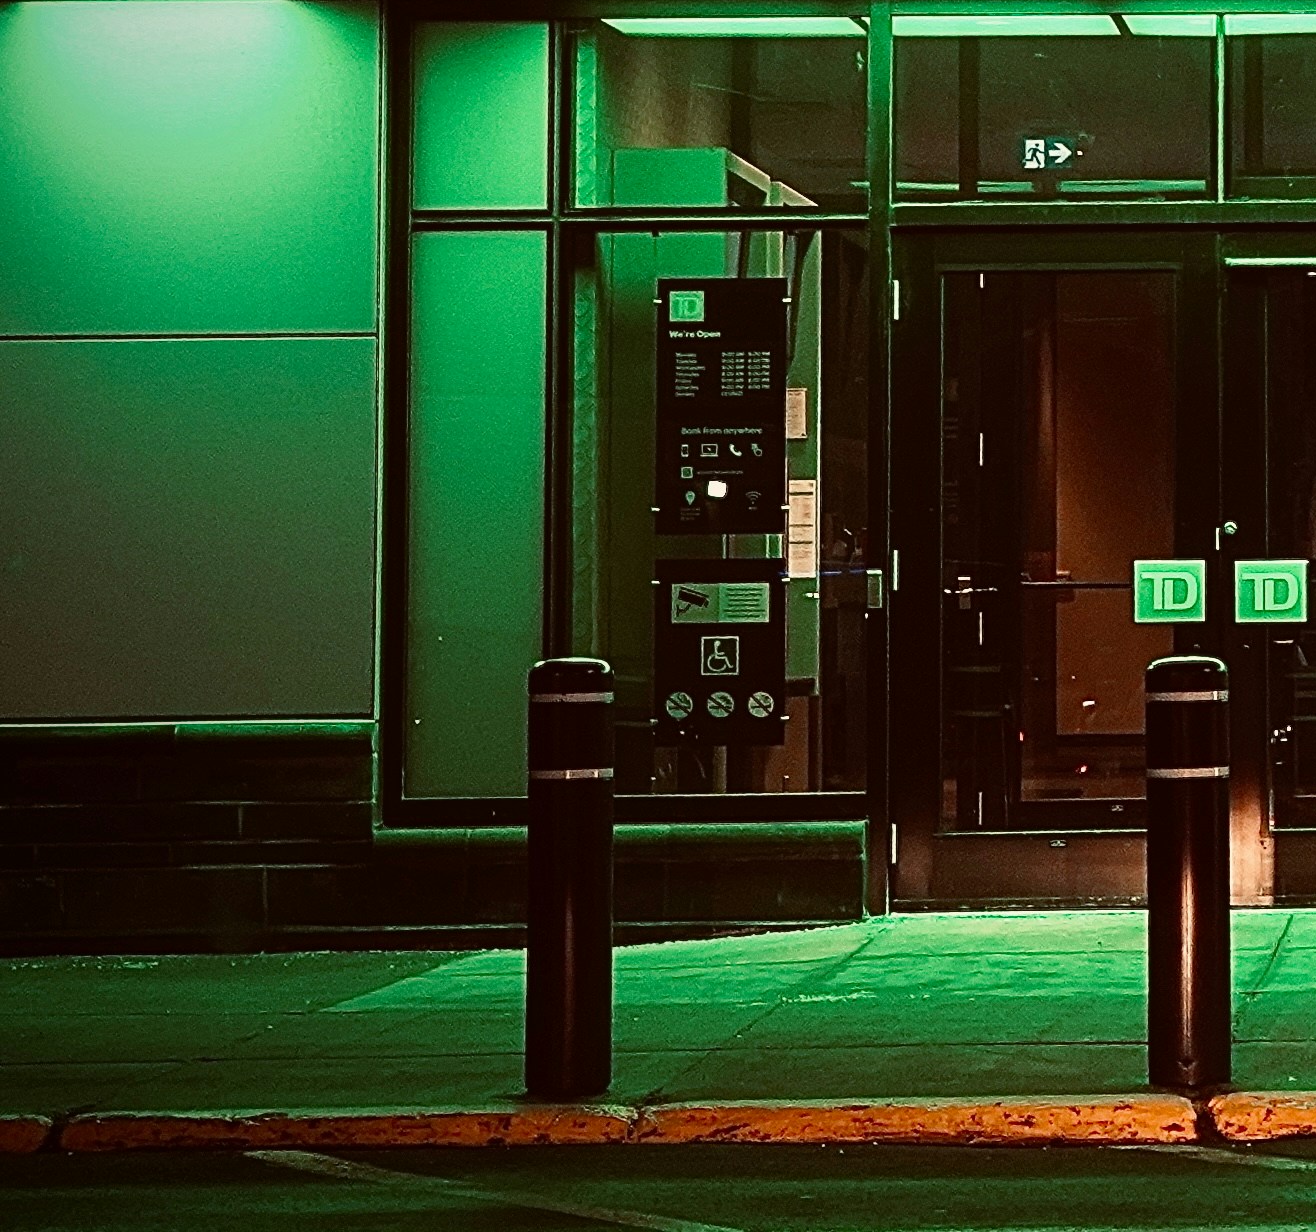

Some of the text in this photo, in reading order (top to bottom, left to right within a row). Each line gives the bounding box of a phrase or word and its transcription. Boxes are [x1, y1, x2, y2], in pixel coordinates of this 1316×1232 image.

[696, 330, 721, 338] Open
[1141, 571, 1198, 610] TD
[1242, 573, 1299, 610] TD
